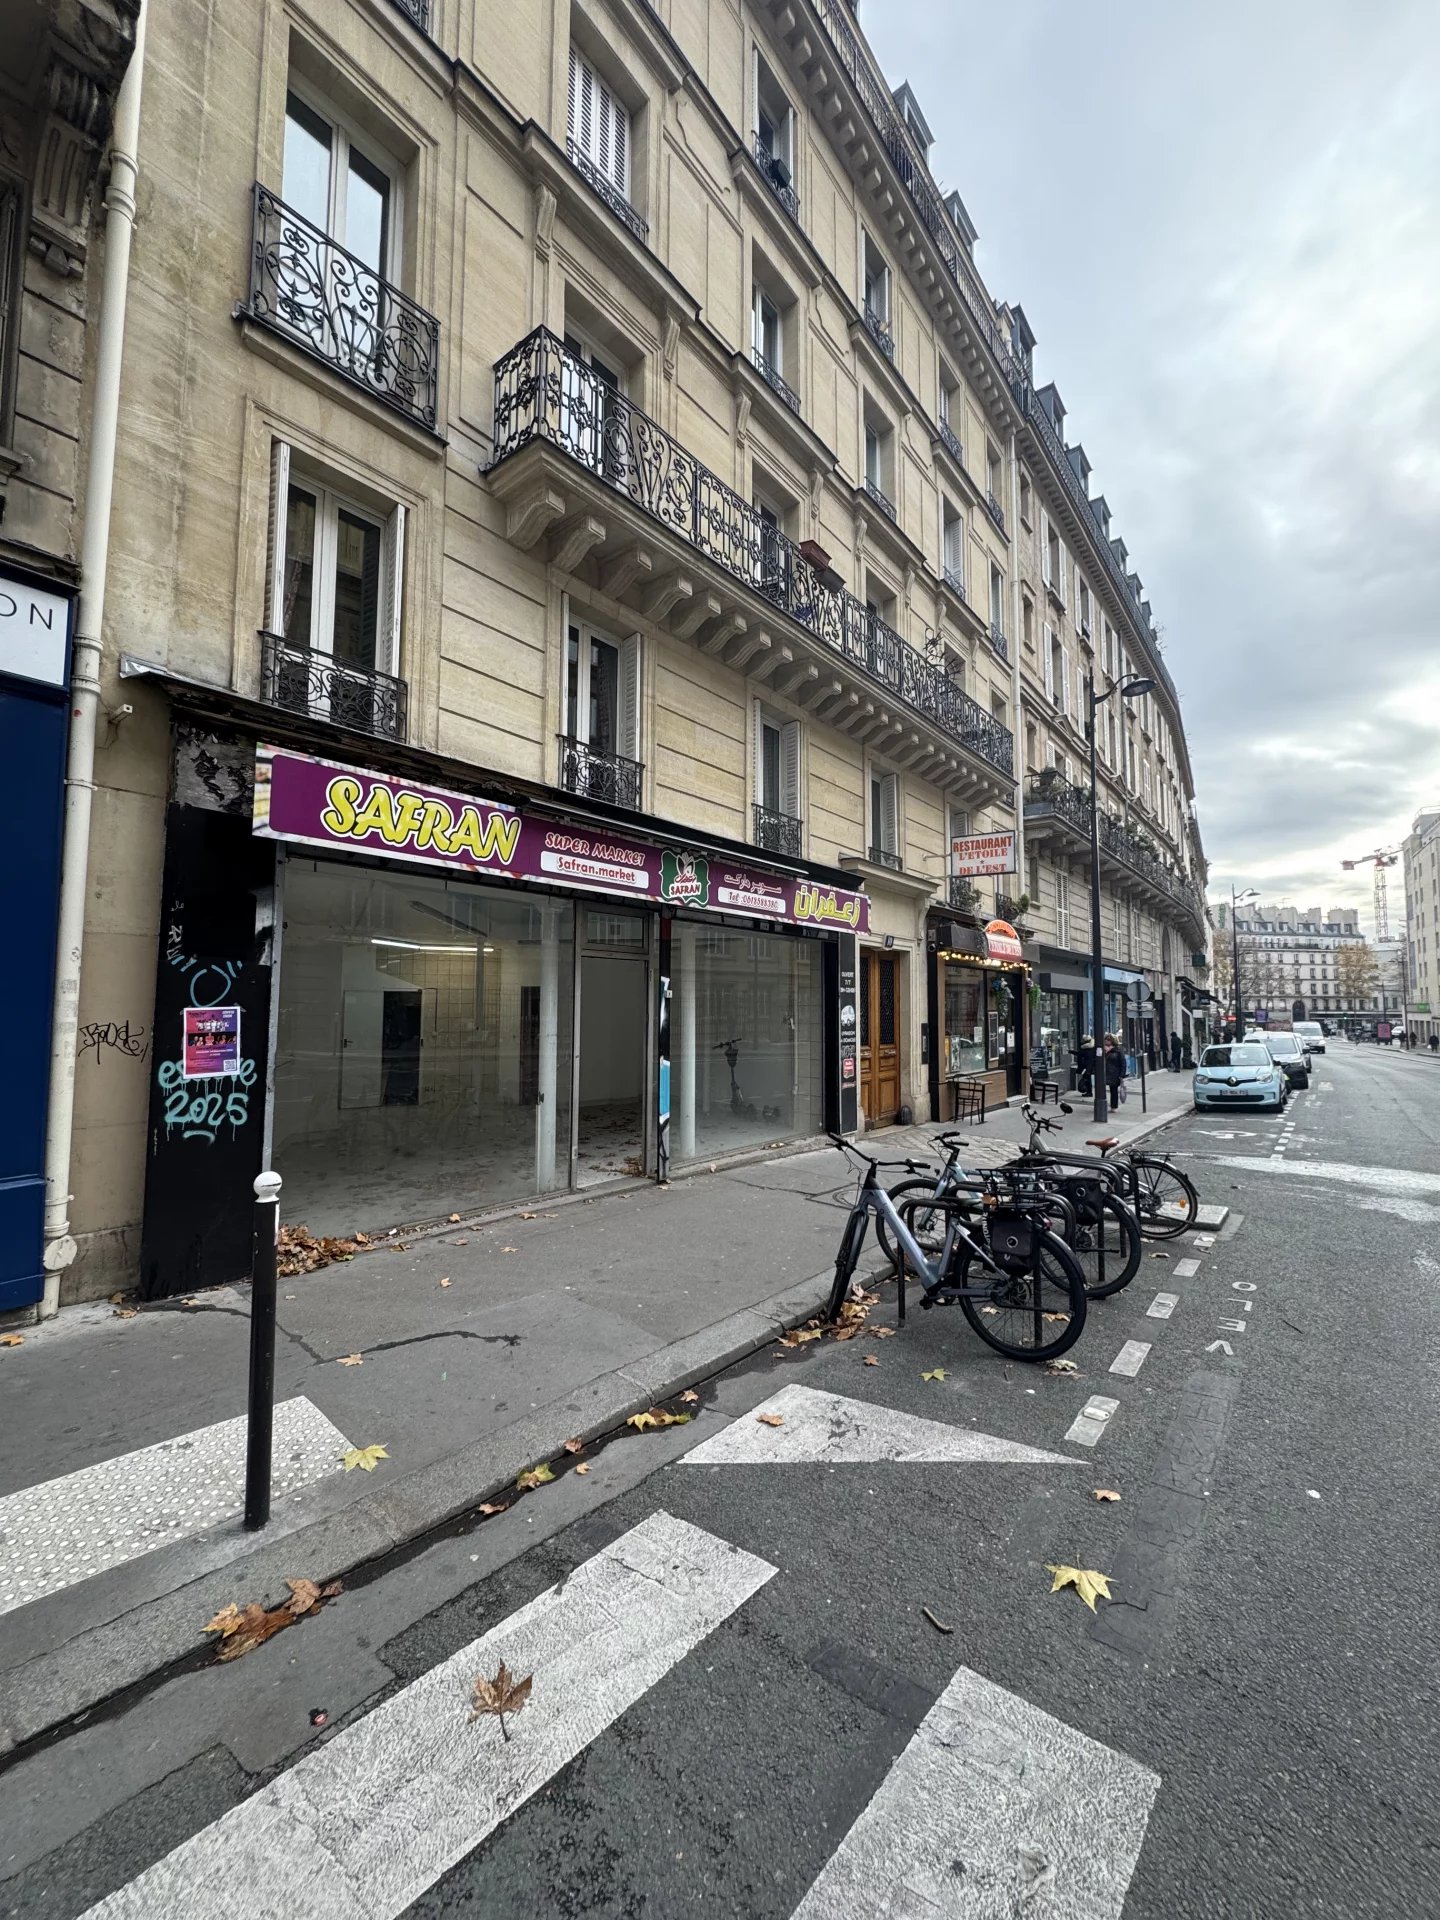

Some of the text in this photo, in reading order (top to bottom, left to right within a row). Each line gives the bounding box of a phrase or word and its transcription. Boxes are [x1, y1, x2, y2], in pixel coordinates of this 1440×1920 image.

[321, 776, 521, 865] SAFRAN
[545, 832, 646, 867] SUPER MARKET
[953, 836, 1013, 852] RESTAURANT
[959, 848, 1008, 861] L'ETOILE
[558, 856, 636, 882] Safran.market
[960, 863, 1007, 875] DE L'EST
[670, 884, 701, 896] SAFRAN
[794, 884, 861, 928] زعفران
[165, 1090, 248, 1126] 2025
